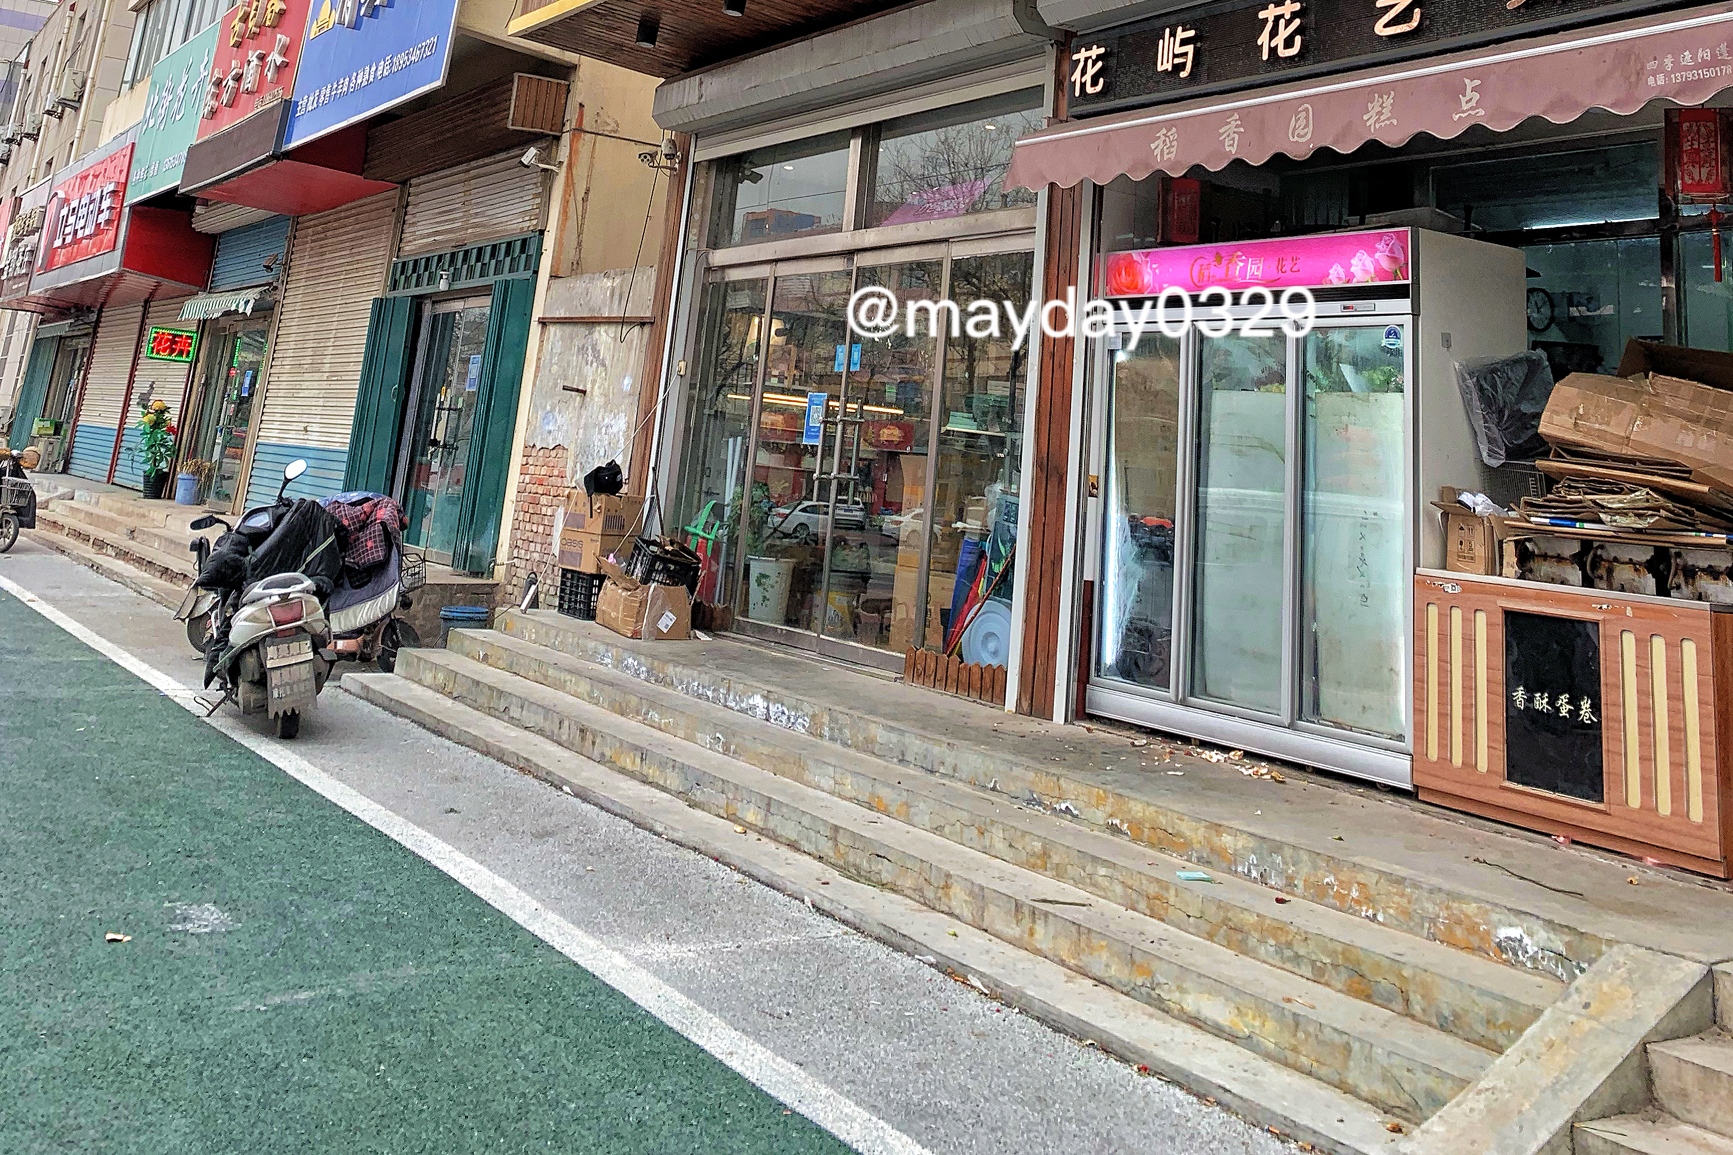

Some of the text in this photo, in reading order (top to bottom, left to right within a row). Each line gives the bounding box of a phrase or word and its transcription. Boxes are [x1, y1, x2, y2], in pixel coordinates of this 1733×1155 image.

[151, 330, 192, 359] 花卉
[1512, 685, 1598, 724] 香酥蛋卷
